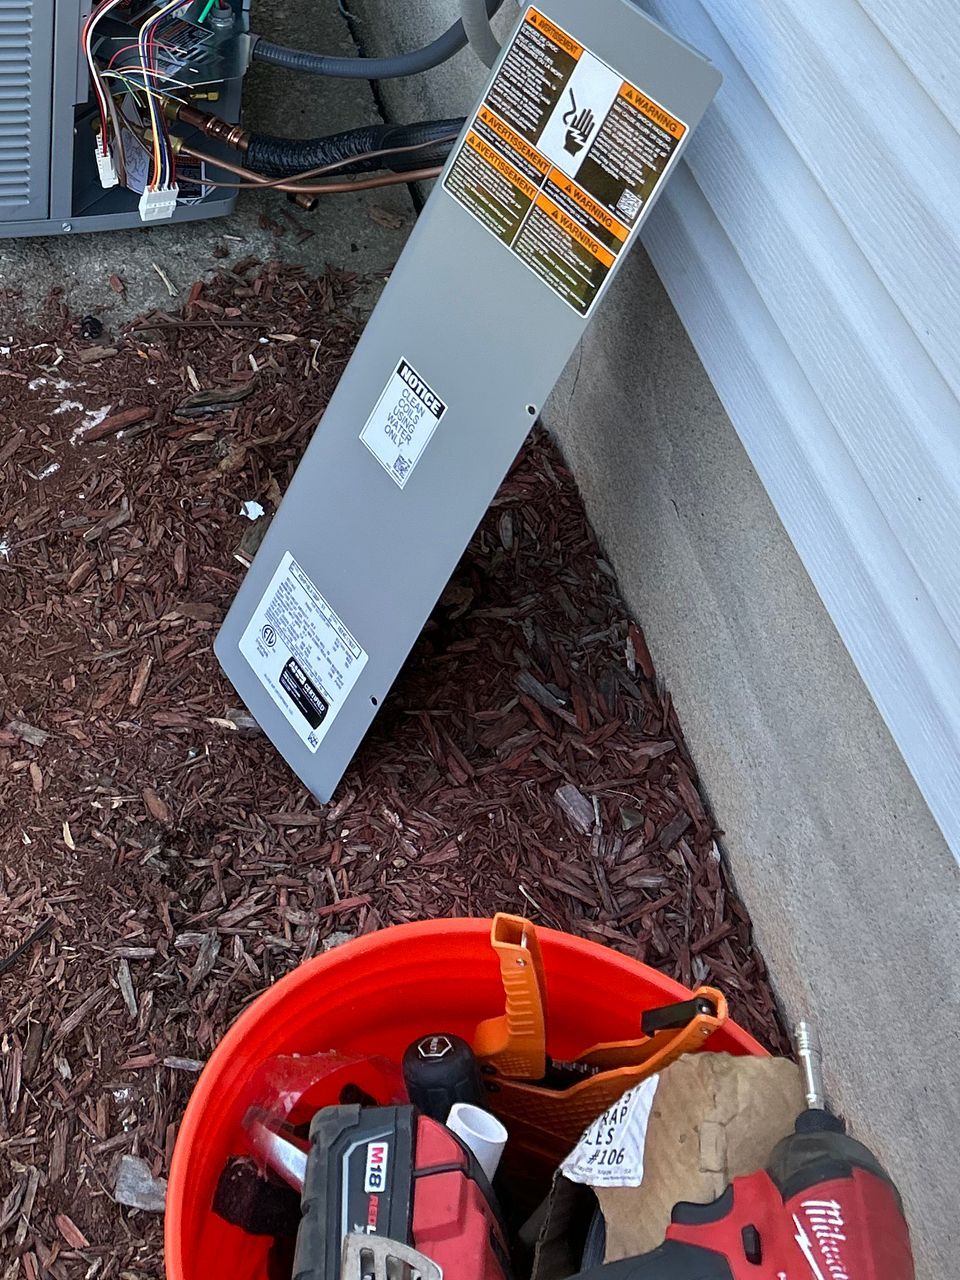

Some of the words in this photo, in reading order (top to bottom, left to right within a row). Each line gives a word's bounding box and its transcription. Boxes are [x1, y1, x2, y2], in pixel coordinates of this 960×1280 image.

[633, 94, 678, 133] WARNING
[487, 115, 548, 172] AVERTISSEMENT
[474, 140, 535, 197] AVERTISSEMENT
[572, 188, 613, 228] WARNING
[558, 214, 599, 254] WARNING
[400, 365, 441, 416] NOTICE
[402, 388, 425, 417] CLEAN
[387, 413, 412, 445] WATER
[393, 406, 416, 434] USING
[398, 398, 419, 425] COILS
[384, 424, 404, 448] ONLY
[369, 1146, 385, 1189] M18
[587, 1148, 625, 1166] #106
[366, 1193, 379, 1235] REDL
